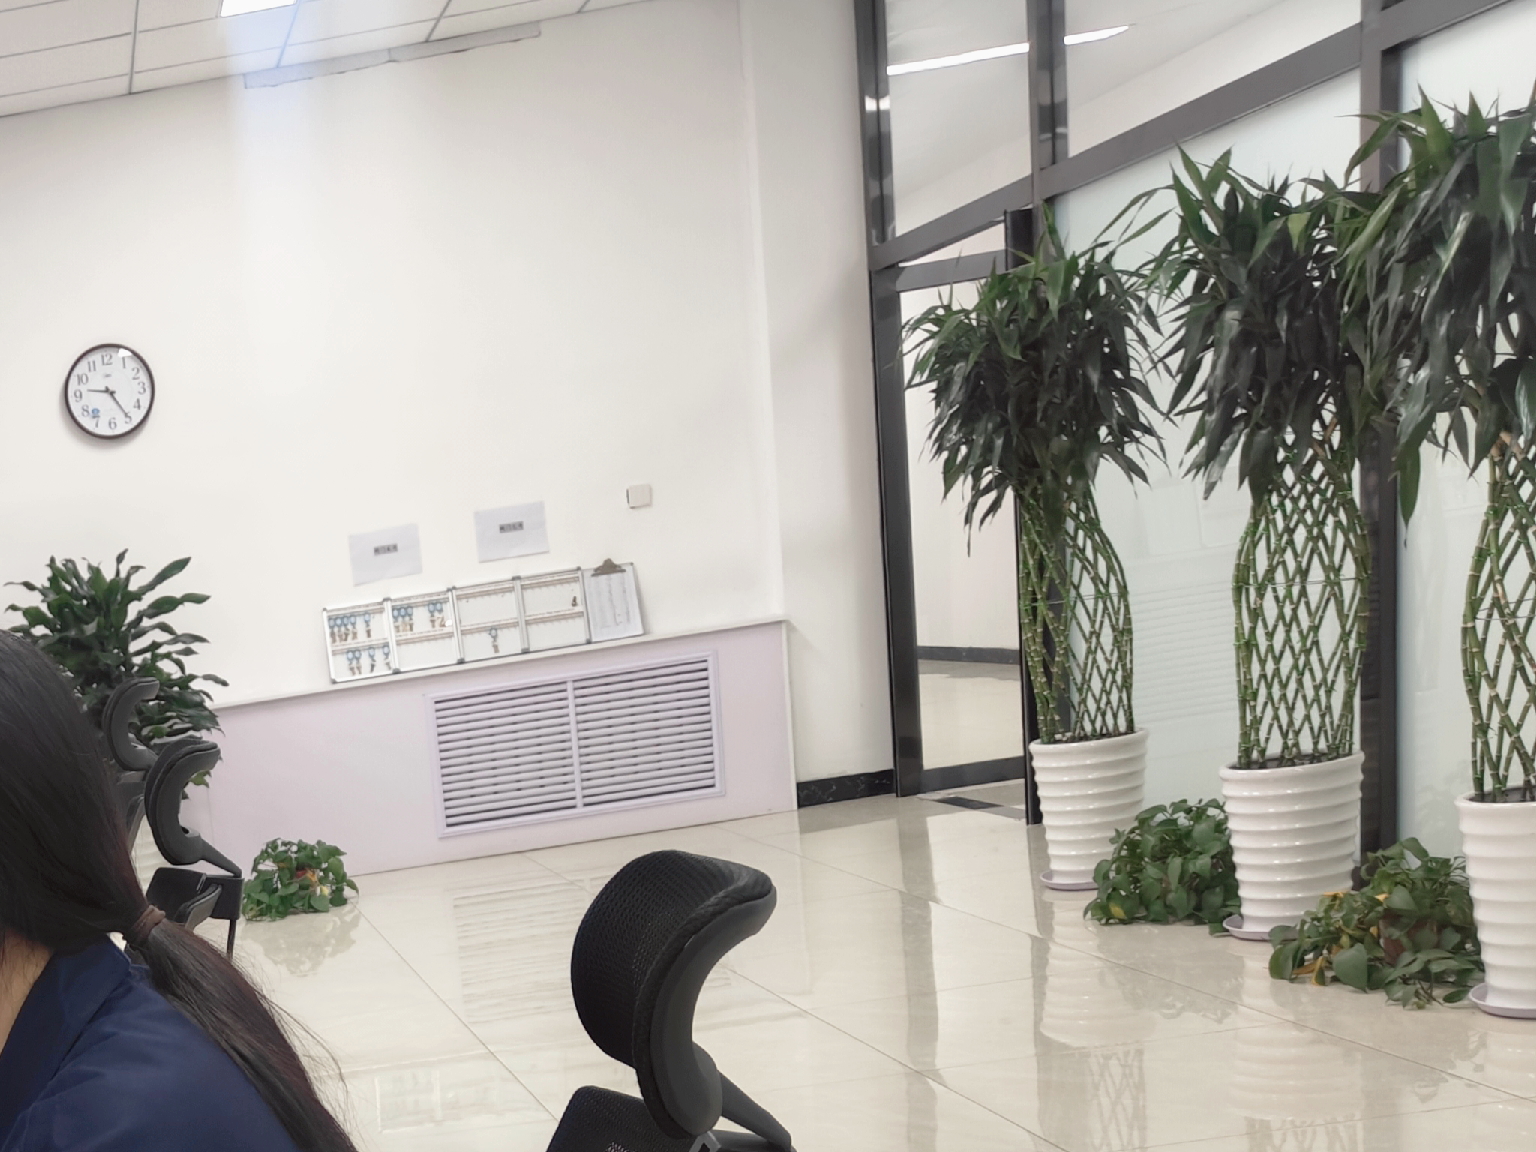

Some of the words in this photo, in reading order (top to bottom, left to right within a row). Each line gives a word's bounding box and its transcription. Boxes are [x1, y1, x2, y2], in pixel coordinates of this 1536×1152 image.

[101, 353, 113, 365] 12
[87, 360, 96, 372] 11
[76, 373, 89, 386] 10
[131, 367, 141, 380] 2
[137, 381, 147, 395] 3
[73, 390, 83, 402] 9
[133, 397, 142, 411] 4
[81, 405, 90, 417] 8
[91, 415, 100, 428] 7
[108, 417, 117, 430] 6
